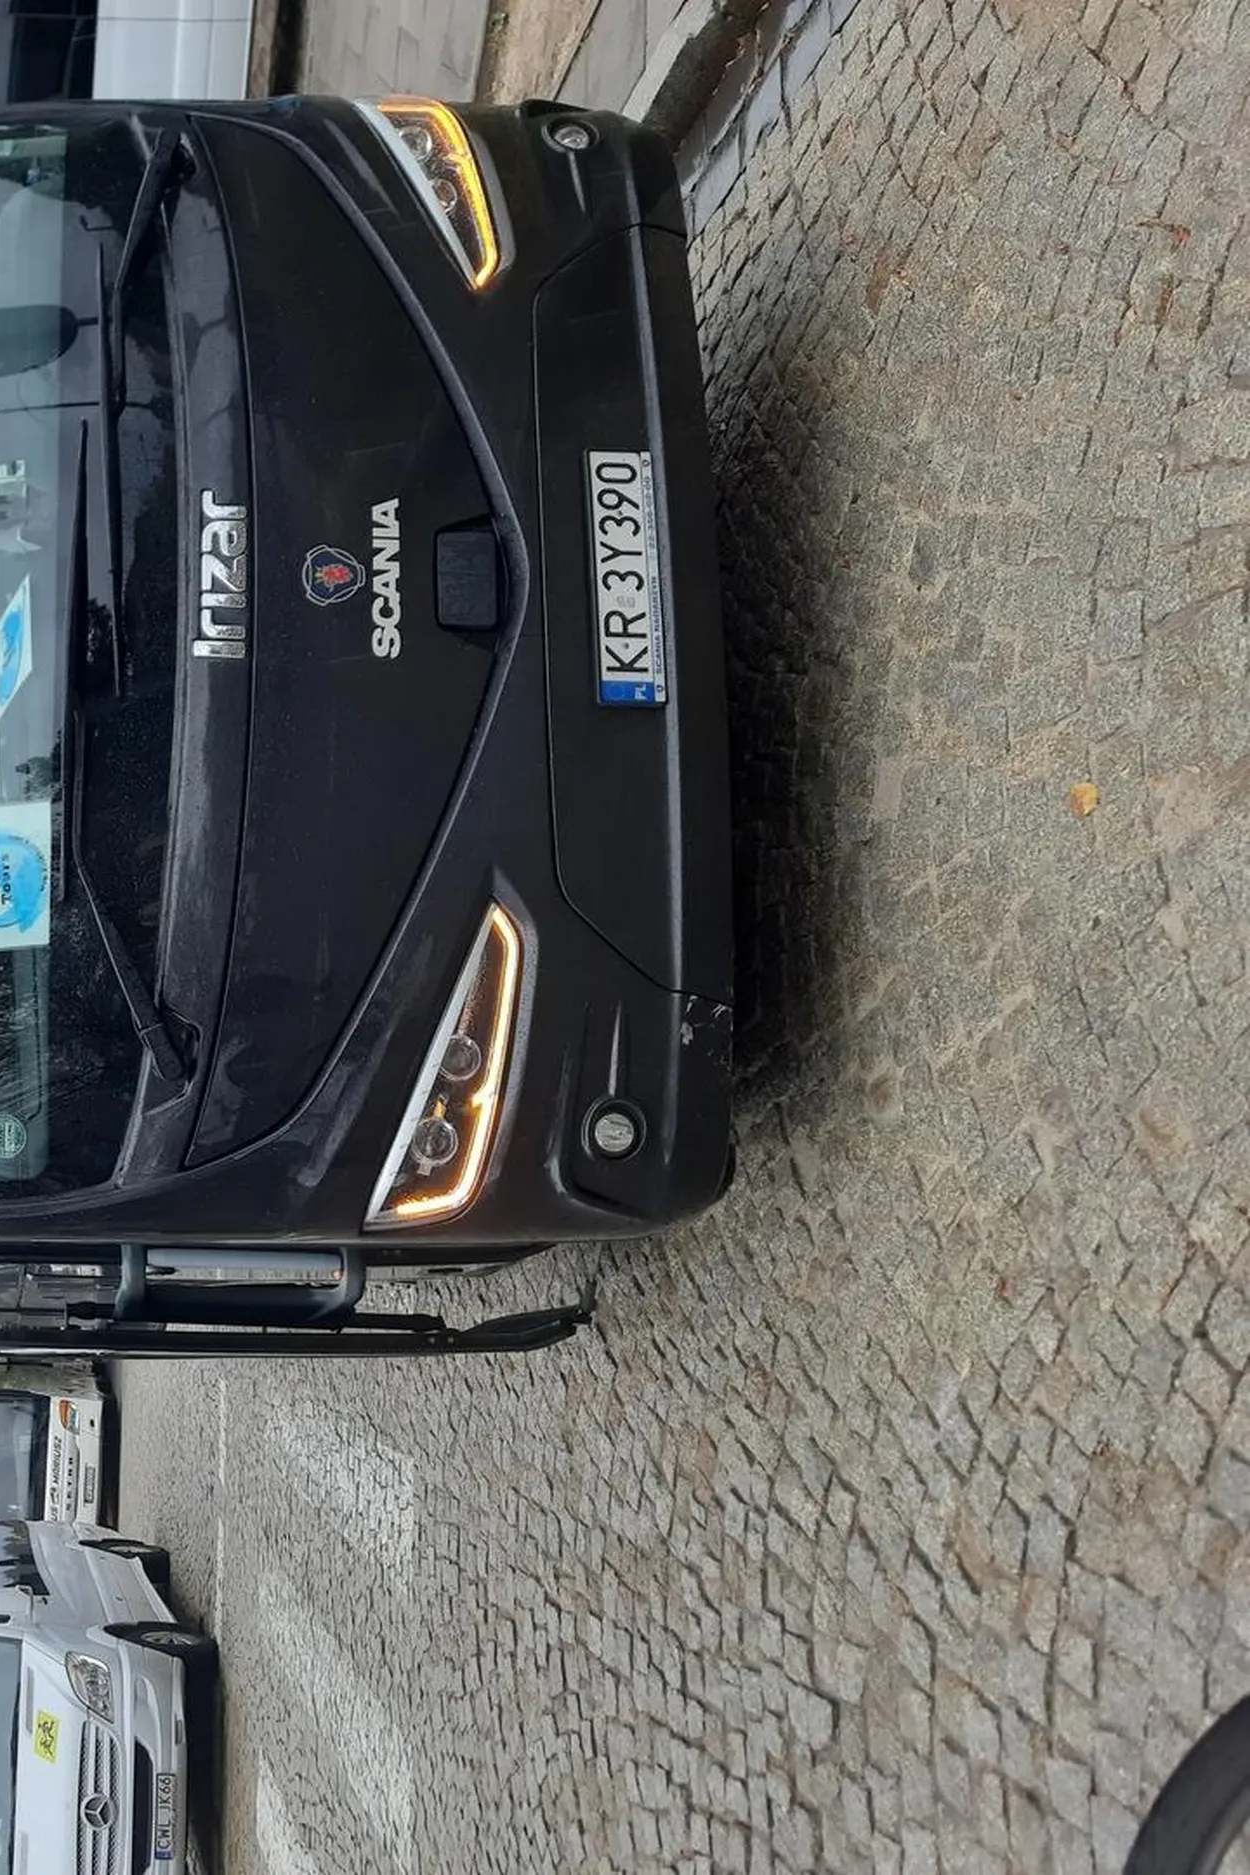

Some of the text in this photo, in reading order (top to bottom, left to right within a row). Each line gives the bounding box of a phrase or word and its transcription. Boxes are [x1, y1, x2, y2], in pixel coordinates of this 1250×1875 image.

[192, 489, 248, 660] Irizar
[371, 498, 401, 659] SCANIA
[595, 461, 649, 674] KR 3Y390
[654, 634, 663, 674] SCANIA
[634, 683, 649, 701] PL
[0, 854, 13, 905] Tours
[157, 1776, 171, 1850] CWL JK66
